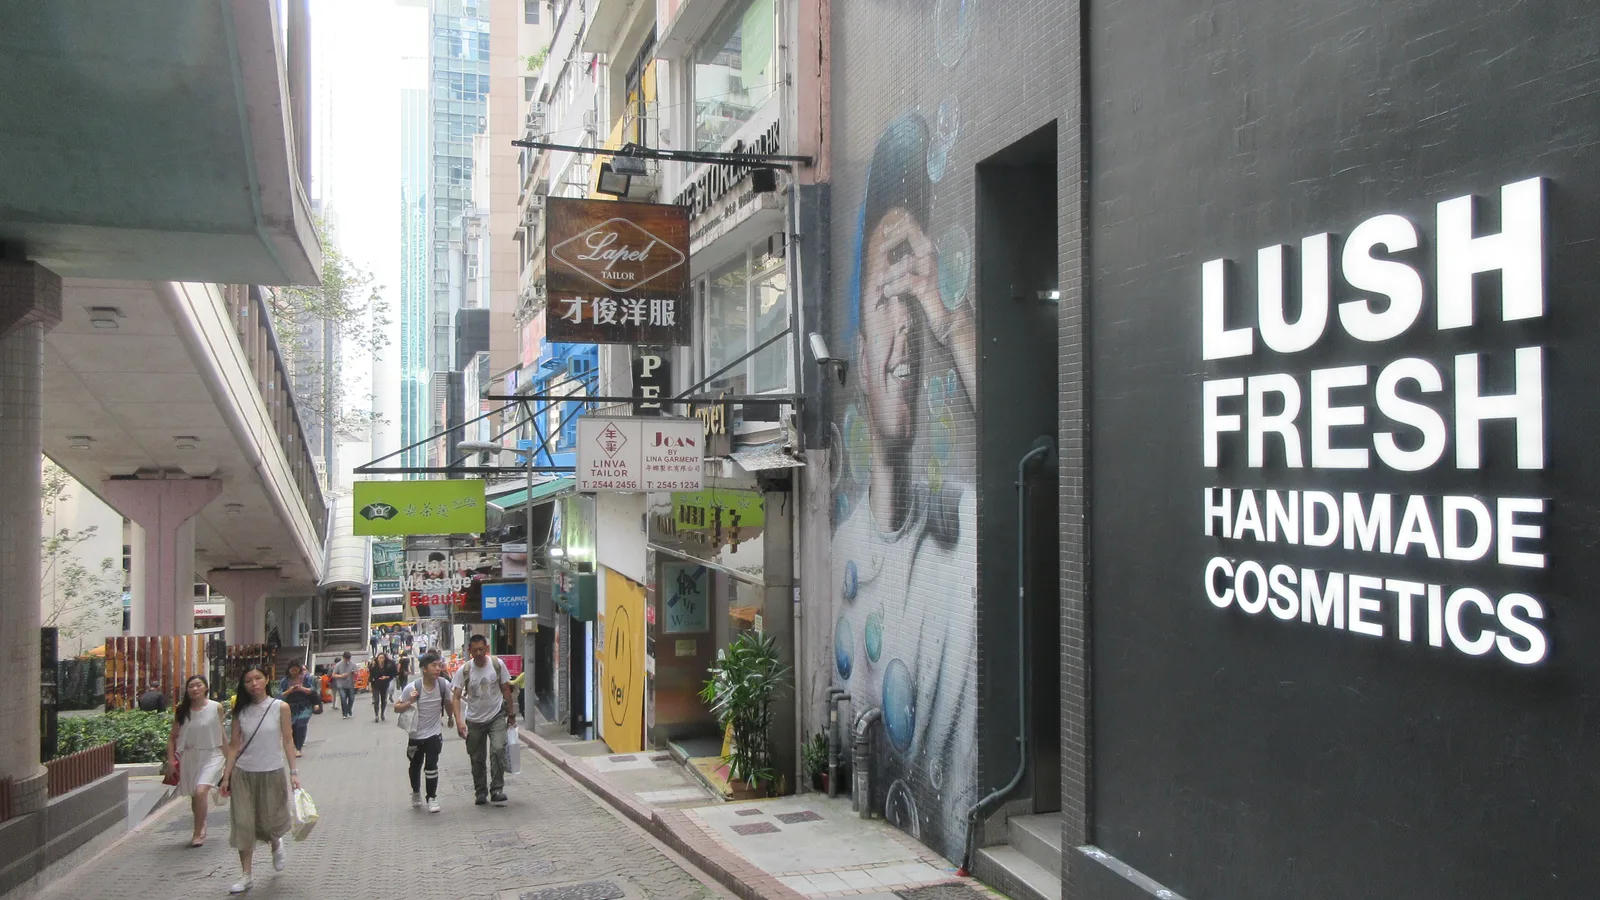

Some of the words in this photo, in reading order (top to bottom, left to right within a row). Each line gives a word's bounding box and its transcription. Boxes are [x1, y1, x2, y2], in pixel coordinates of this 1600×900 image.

[577, 231, 657, 270] Lapel
[601, 271, 635, 280] TAILOR
[1202, 177, 1543, 361] LUSH
[560, 296, 676, 327] 才俊洋服
[1202, 346, 1544, 472] FRESH
[593, 459, 626, 468] LINVA
[591, 469, 628, 477] TAILOR
[582, 481, 590, 489] T:
[592, 481, 613, 489] 2544
[615, 481, 637, 489] 2456
[647, 481, 654, 489] T:
[657, 481, 677, 489] 2545
[680, 481, 699, 489] 1234
[1203, 486, 1546, 569] HANDMADE
[394, 555, 478, 574] Eyelashes
[400, 574, 472, 592] Massage
[410, 591, 469, 608] Beauty
[1203, 556, 1547, 665] COSMETICS
